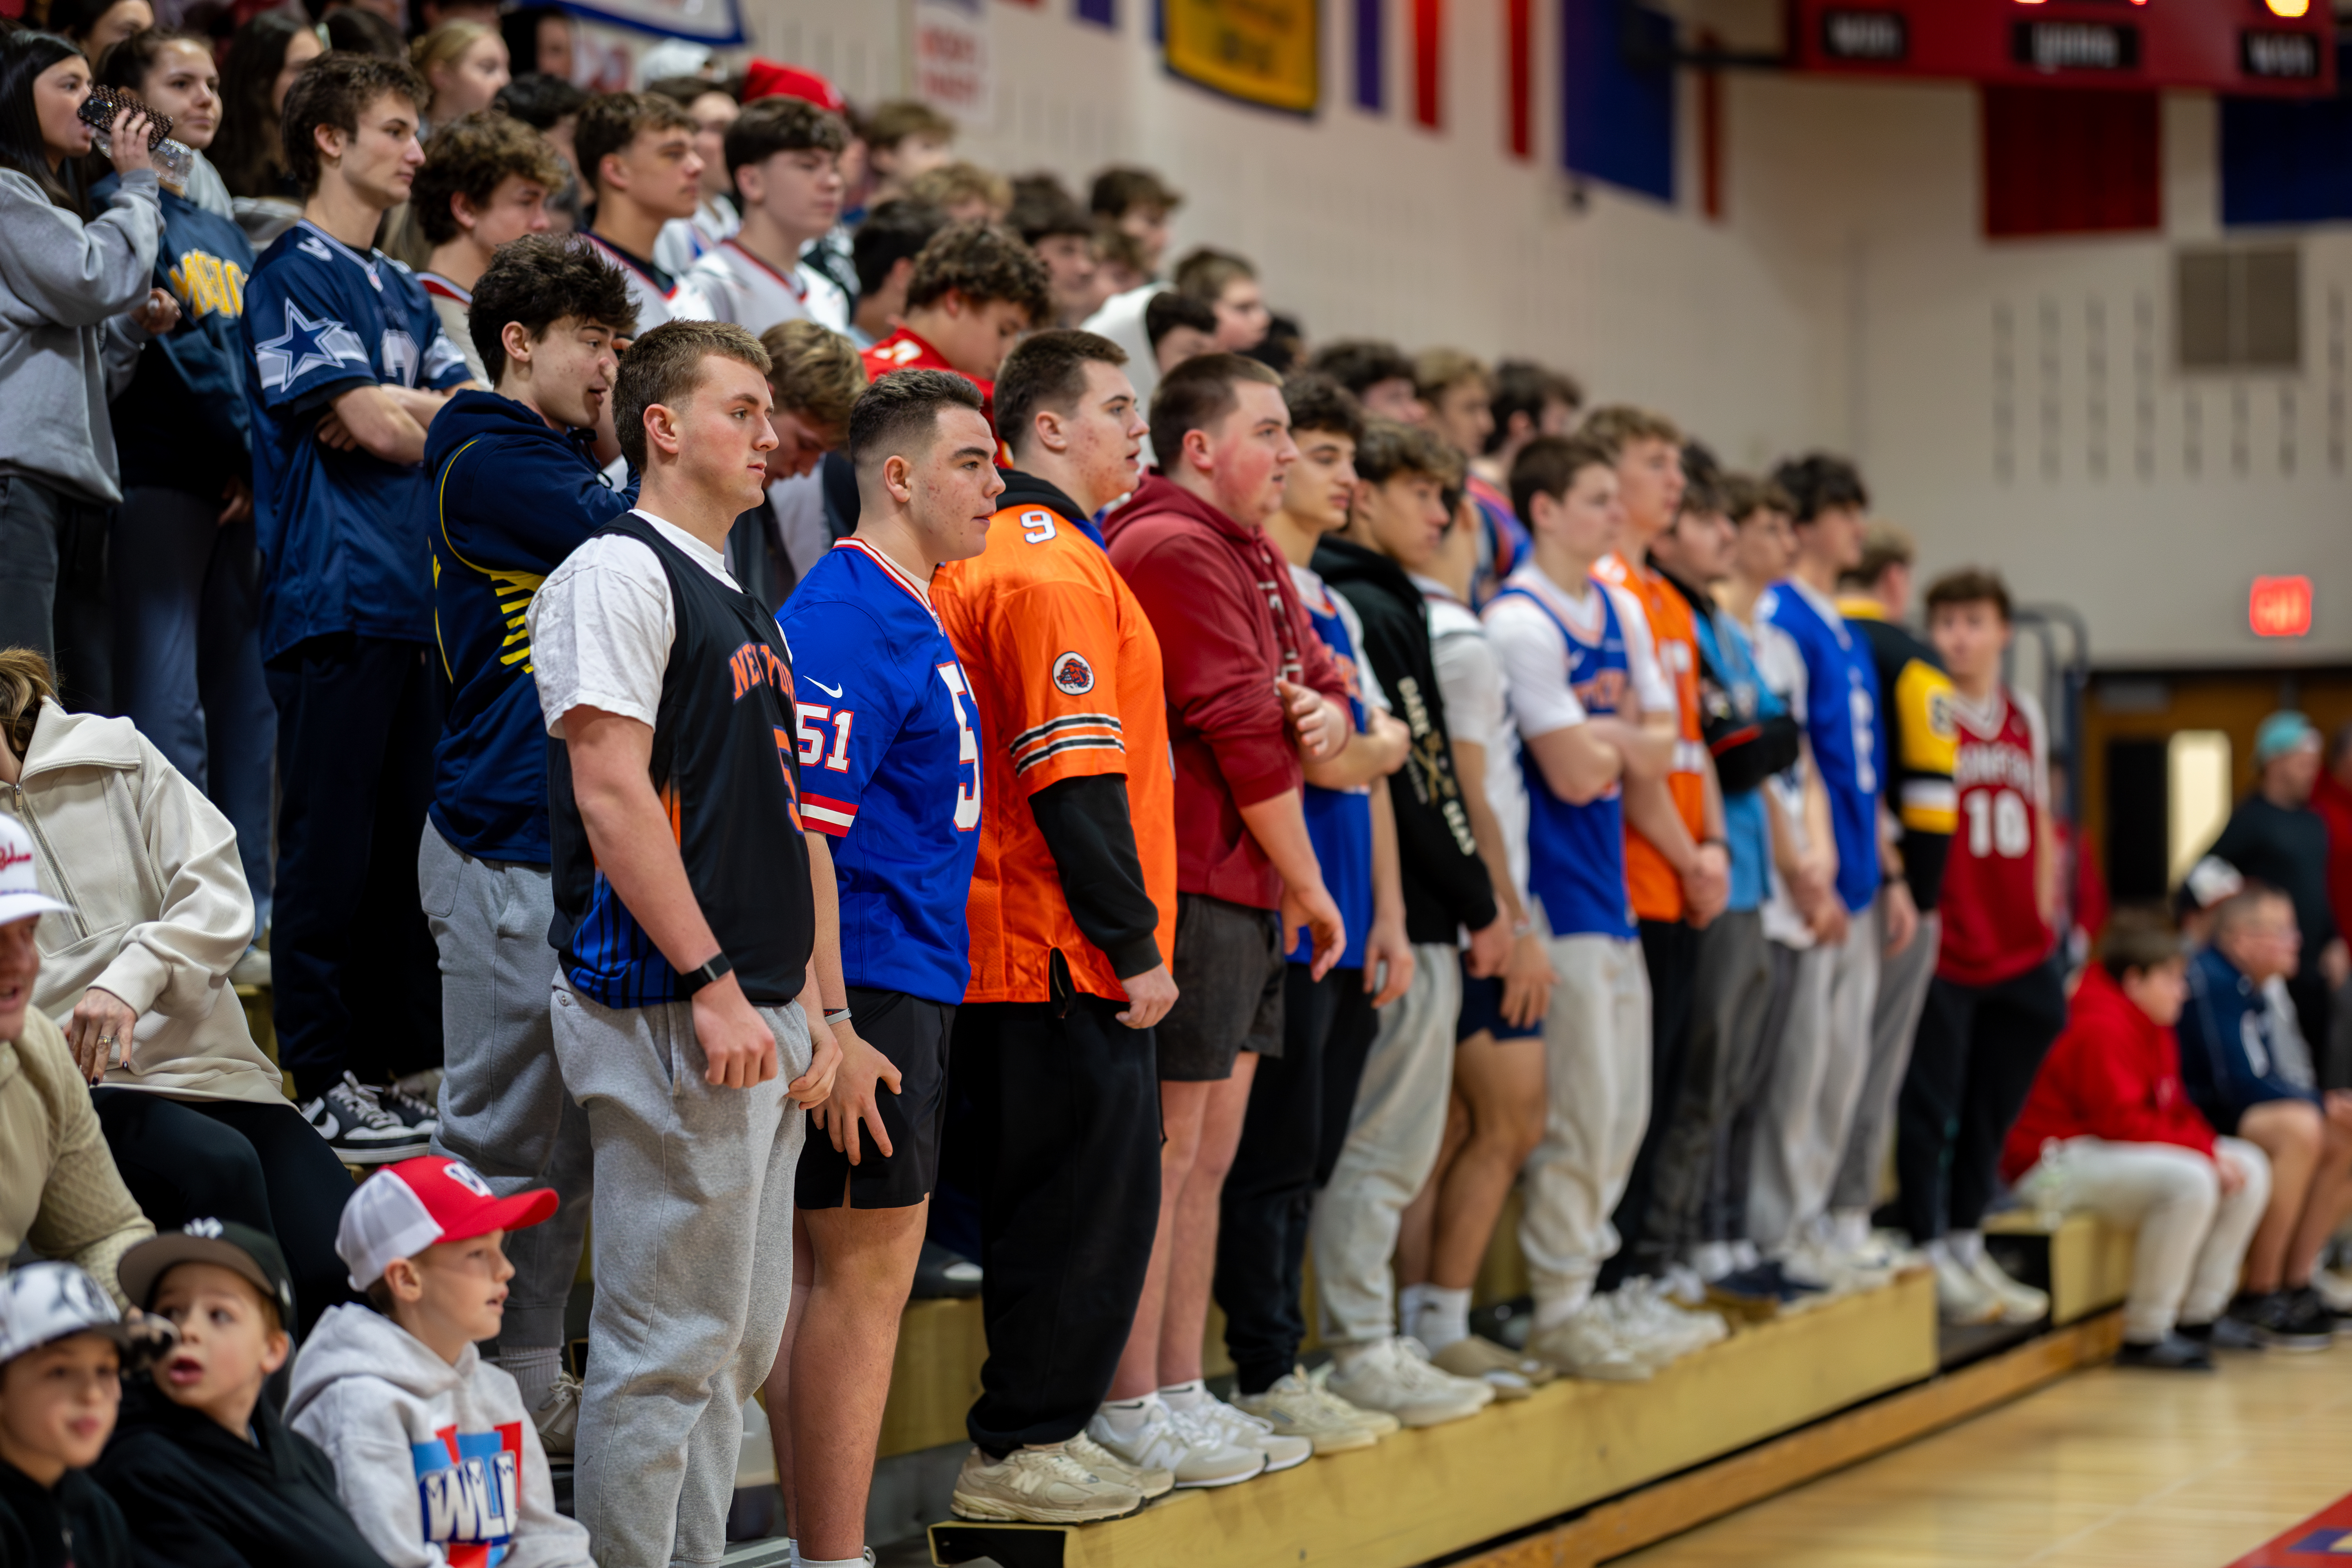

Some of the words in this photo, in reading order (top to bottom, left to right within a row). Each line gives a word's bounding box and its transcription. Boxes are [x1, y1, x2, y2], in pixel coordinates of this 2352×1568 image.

[1020, 510, 1057, 544] 9
[797, 702, 854, 773] 51
[1963, 788, 2031, 858] 10
